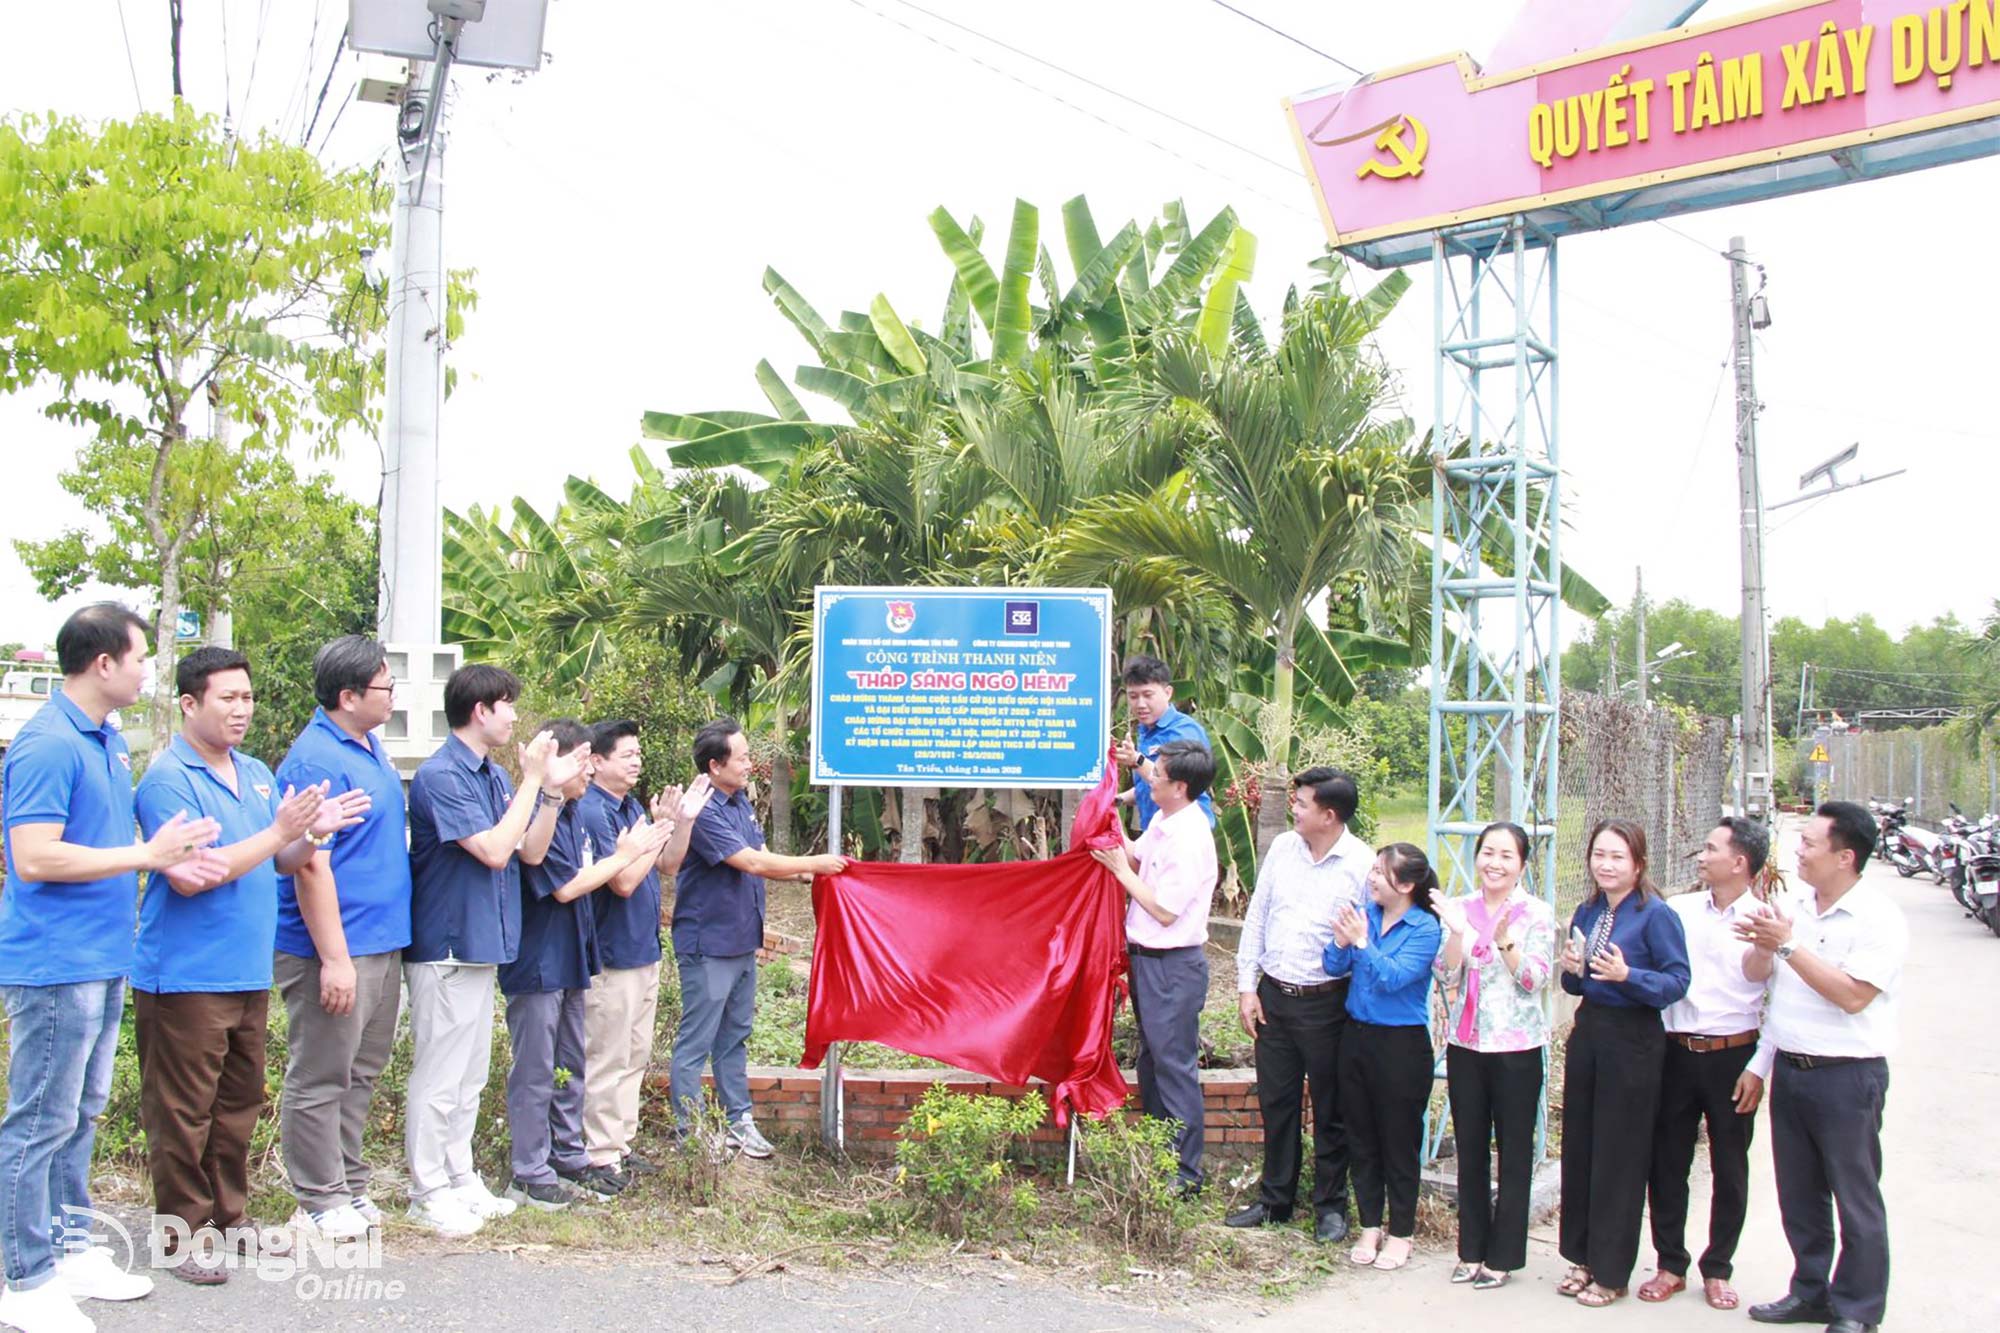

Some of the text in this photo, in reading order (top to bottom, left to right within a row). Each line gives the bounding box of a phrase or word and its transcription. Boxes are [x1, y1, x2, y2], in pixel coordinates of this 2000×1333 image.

[1529, 64, 1654, 168] QUYẾT
[1666, 51, 1764, 133] TÂM
[1780, 20, 1875, 110] XÂY
[866, 649, 1057, 666] CÔNG TRÌNH THANH NIÊN
